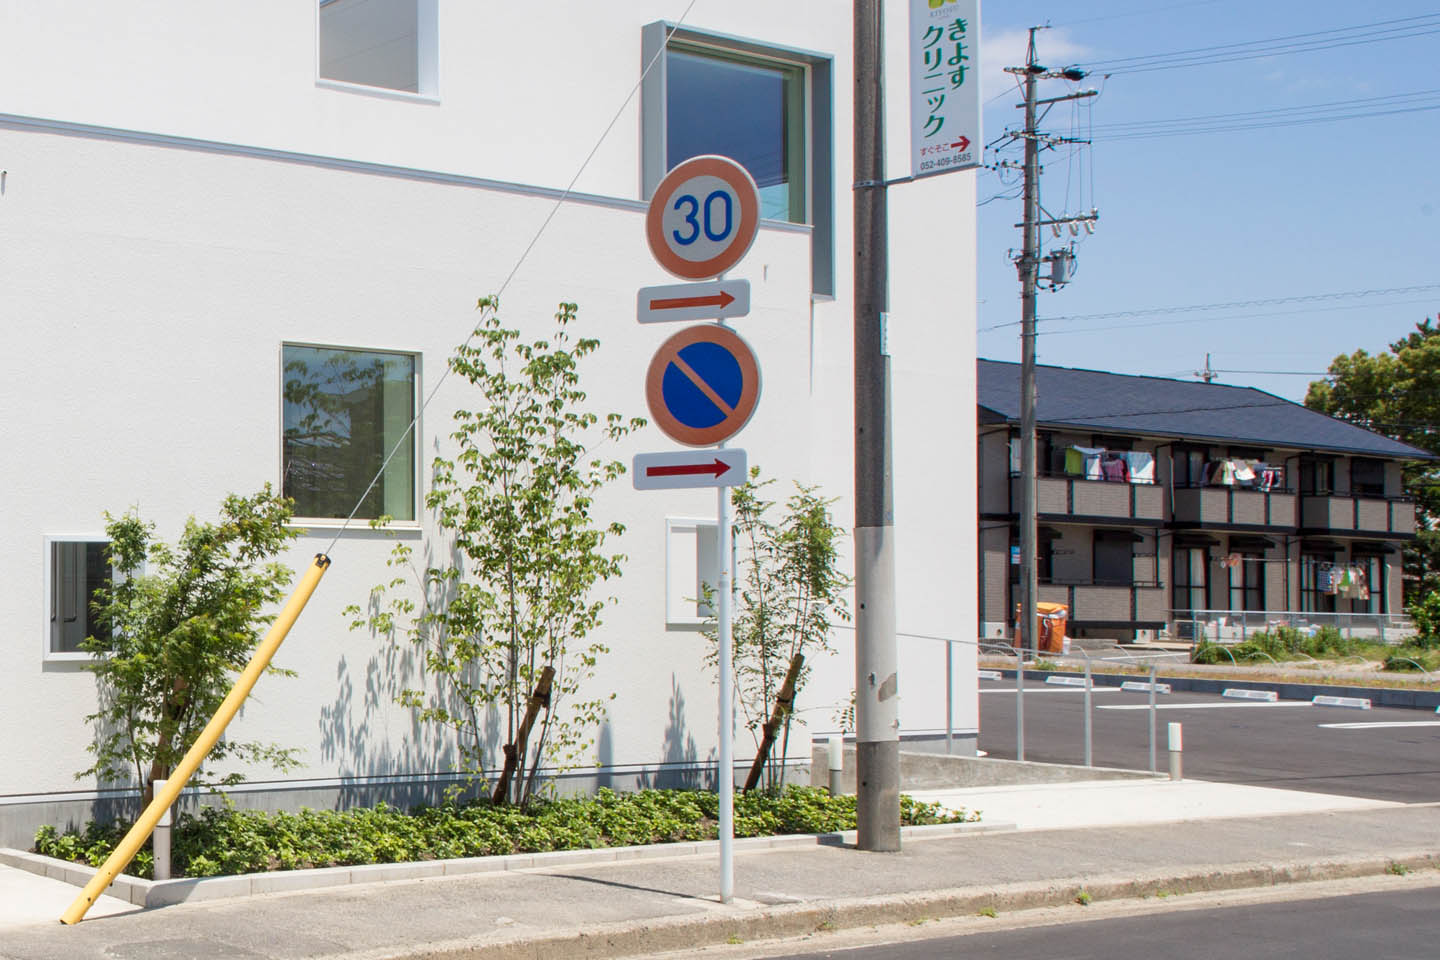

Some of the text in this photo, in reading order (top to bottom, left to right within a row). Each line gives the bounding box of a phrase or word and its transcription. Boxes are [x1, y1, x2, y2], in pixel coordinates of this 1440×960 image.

[922, 25, 946, 138] クリニック
[947, 18, 970, 90] きよす
[672, 190, 732, 246] 30
